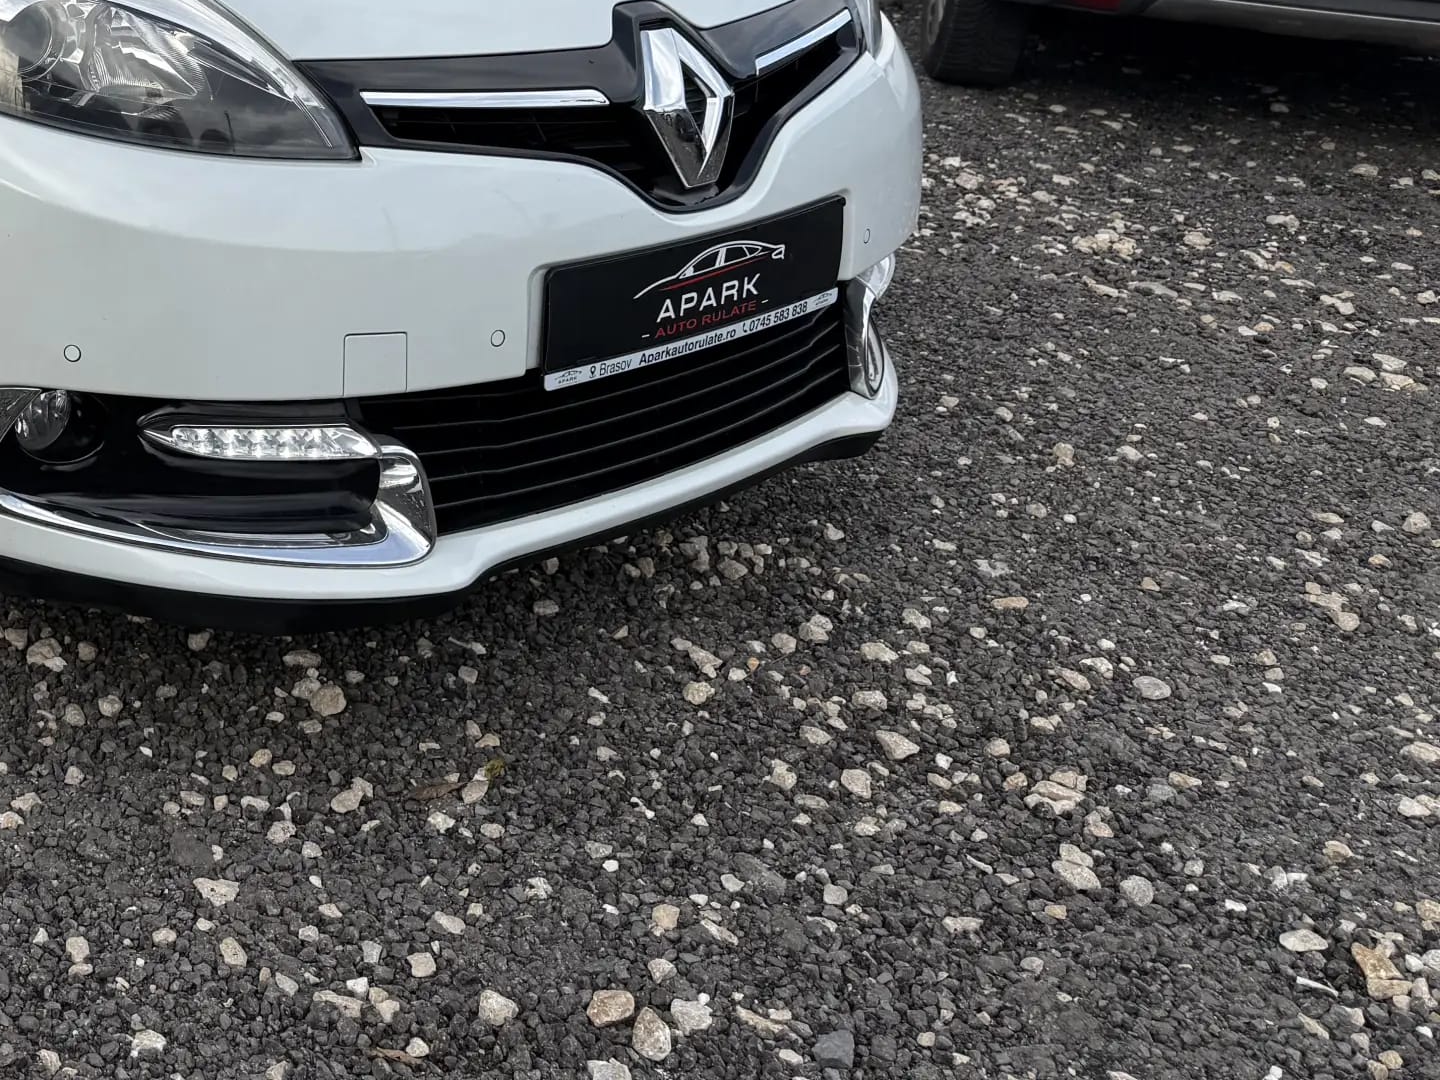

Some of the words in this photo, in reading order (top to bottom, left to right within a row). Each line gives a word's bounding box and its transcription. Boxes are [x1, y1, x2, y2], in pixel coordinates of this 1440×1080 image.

[655, 319, 697, 339] AUTO
[701, 300, 757, 326] RULATE
[656, 273, 761, 323] APARK
[599, 359, 632, 376] Brasov
[639, 329, 736, 365] Aparkautorulate.ro
[749, 315, 771, 331] 0745
[773, 307, 790, 323] 583
[791, 301, 808, 317] 838
